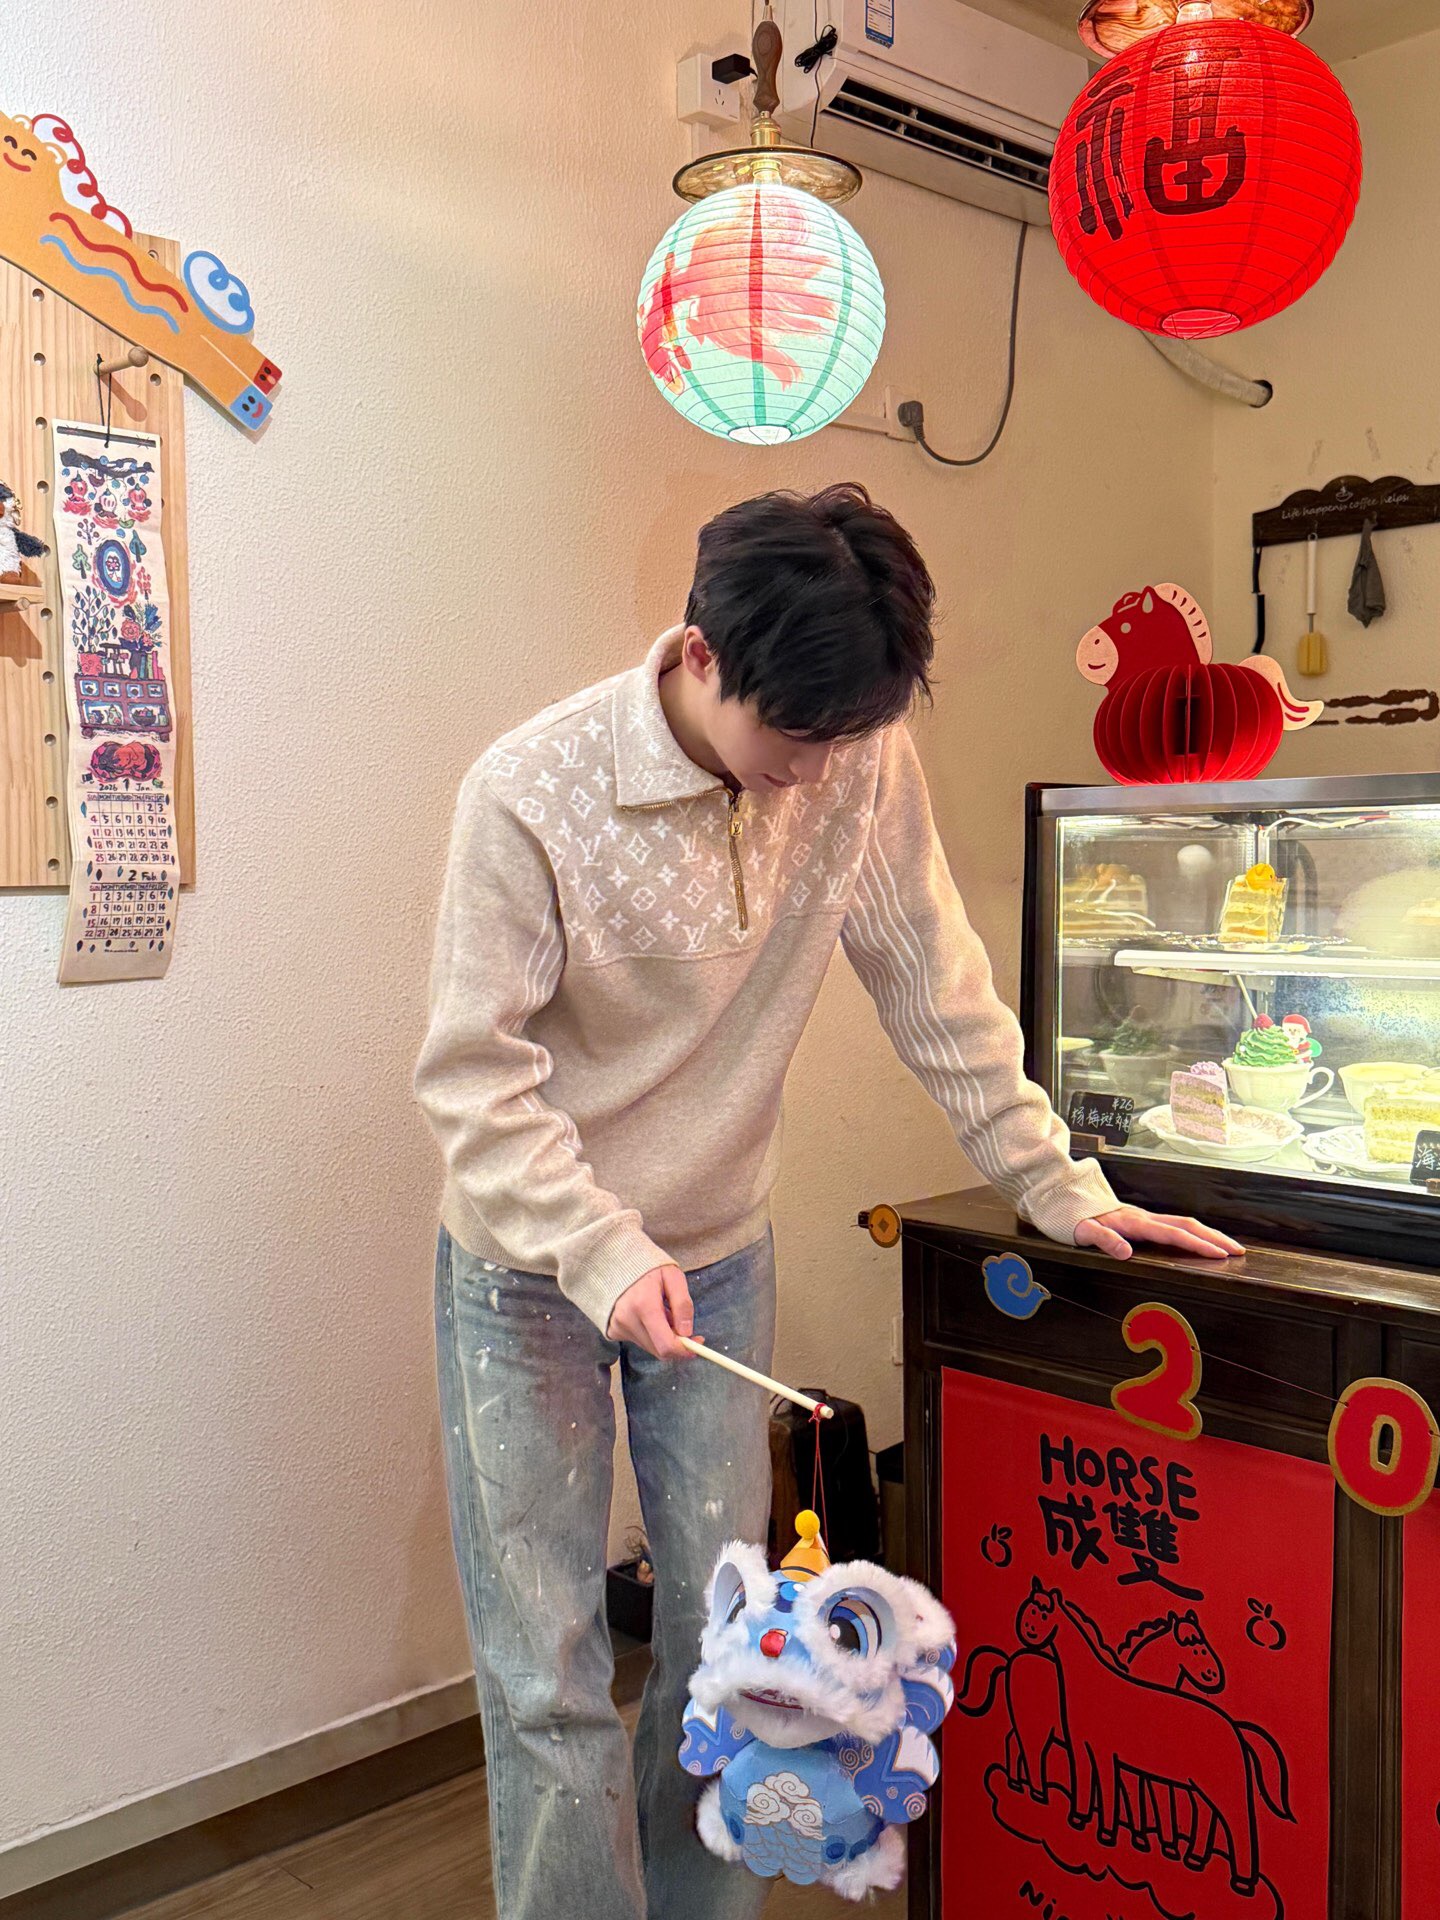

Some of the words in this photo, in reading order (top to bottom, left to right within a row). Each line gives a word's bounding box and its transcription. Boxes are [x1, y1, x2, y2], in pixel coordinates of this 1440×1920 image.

[1349, 497, 1378, 511] coffee
[147, 804, 154, 812] 2
[158, 804, 163, 812] 3
[91, 815, 97, 823] 4
[102, 815, 109, 823] 5
[115, 815, 121, 823] 6
[126, 816, 132, 824] 7
[137, 815, 143, 824] 8
[148, 816, 154, 824] 9
[158, 816, 166, 824] 10
[116, 829, 123, 837] 13
[138, 829, 145, 837] 15
[160, 829, 166, 837] 17
[95, 841, 102, 849] 18
[128, 841, 135, 849] 21
[139, 841, 146, 849] 22
[149, 841, 157, 849] 23
[160, 841, 168, 849] 24
[96, 854, 104, 862] 25
[162, 854, 169, 862] 31
[128, 870, 137, 881] 2
[117, 892, 122, 900] 3
[127, 892, 133, 900] 4
[139, 892, 144, 900] 5
[91, 905, 96, 914] 8
[103, 904, 109, 912] 9
[148, 903, 154, 911] 13
[159, 903, 165, 911] 14
[113, 917, 120, 925] 17
[124, 917, 132, 925] 18
[136, 916, 143, 924] 19
[97, 929, 105, 937] 23
[156, 928, 163, 936] 28
[1112, 1097, 1133, 1111] ¥26
[1111, 1302, 1203, 1441] 2
[1328, 1377, 1440, 1517] 0
[1040, 1433, 1200, 1521] HORSE
[1037, 1492, 1204, 1601] 成雙
